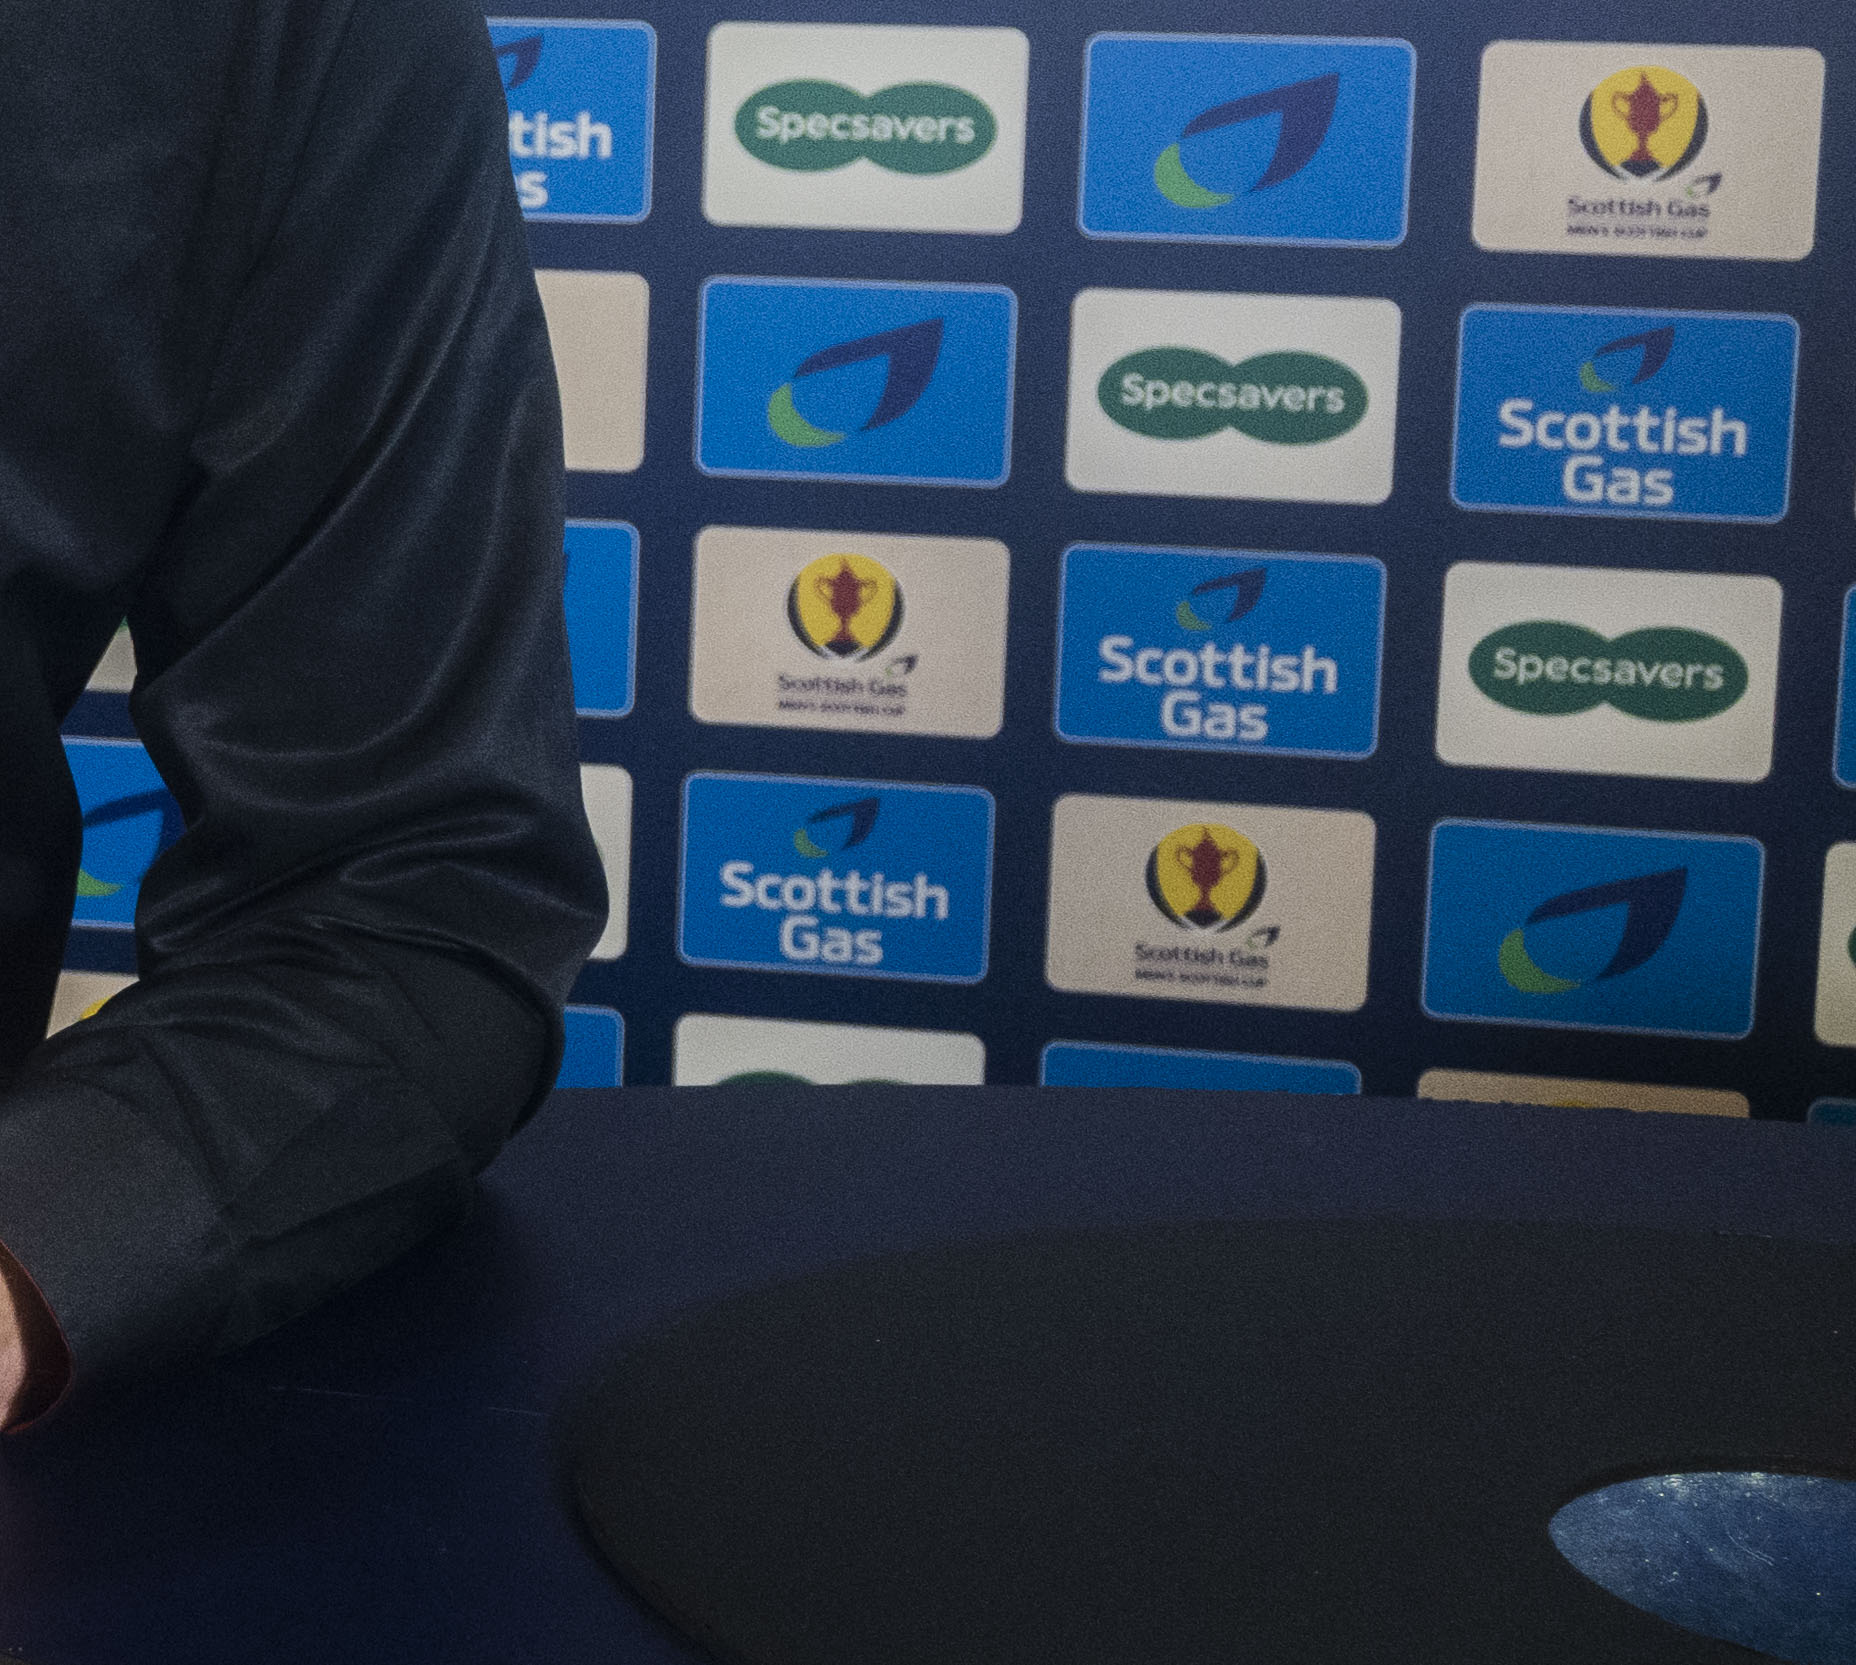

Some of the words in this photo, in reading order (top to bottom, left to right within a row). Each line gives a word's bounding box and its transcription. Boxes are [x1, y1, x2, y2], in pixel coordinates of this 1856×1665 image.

[757, 105, 974, 143] Specsavers
[1568, 196, 1662, 216] Scottish
[1667, 196, 1710, 218] Gas
[1122, 372, 1344, 413] Specsavers
[1497, 397, 1748, 457] Scottish
[1561, 452, 1675, 507] Gas
[778, 673, 865, 694] Scottish
[1098, 634, 1339, 695] Scottish
[1494, 646, 1723, 690] Specsavers
[1159, 687, 1270, 743] Gas
[719, 860, 950, 921] Scottish
[779, 912, 884, 966] Gas
[1135, 944, 1224, 964] Scottish
